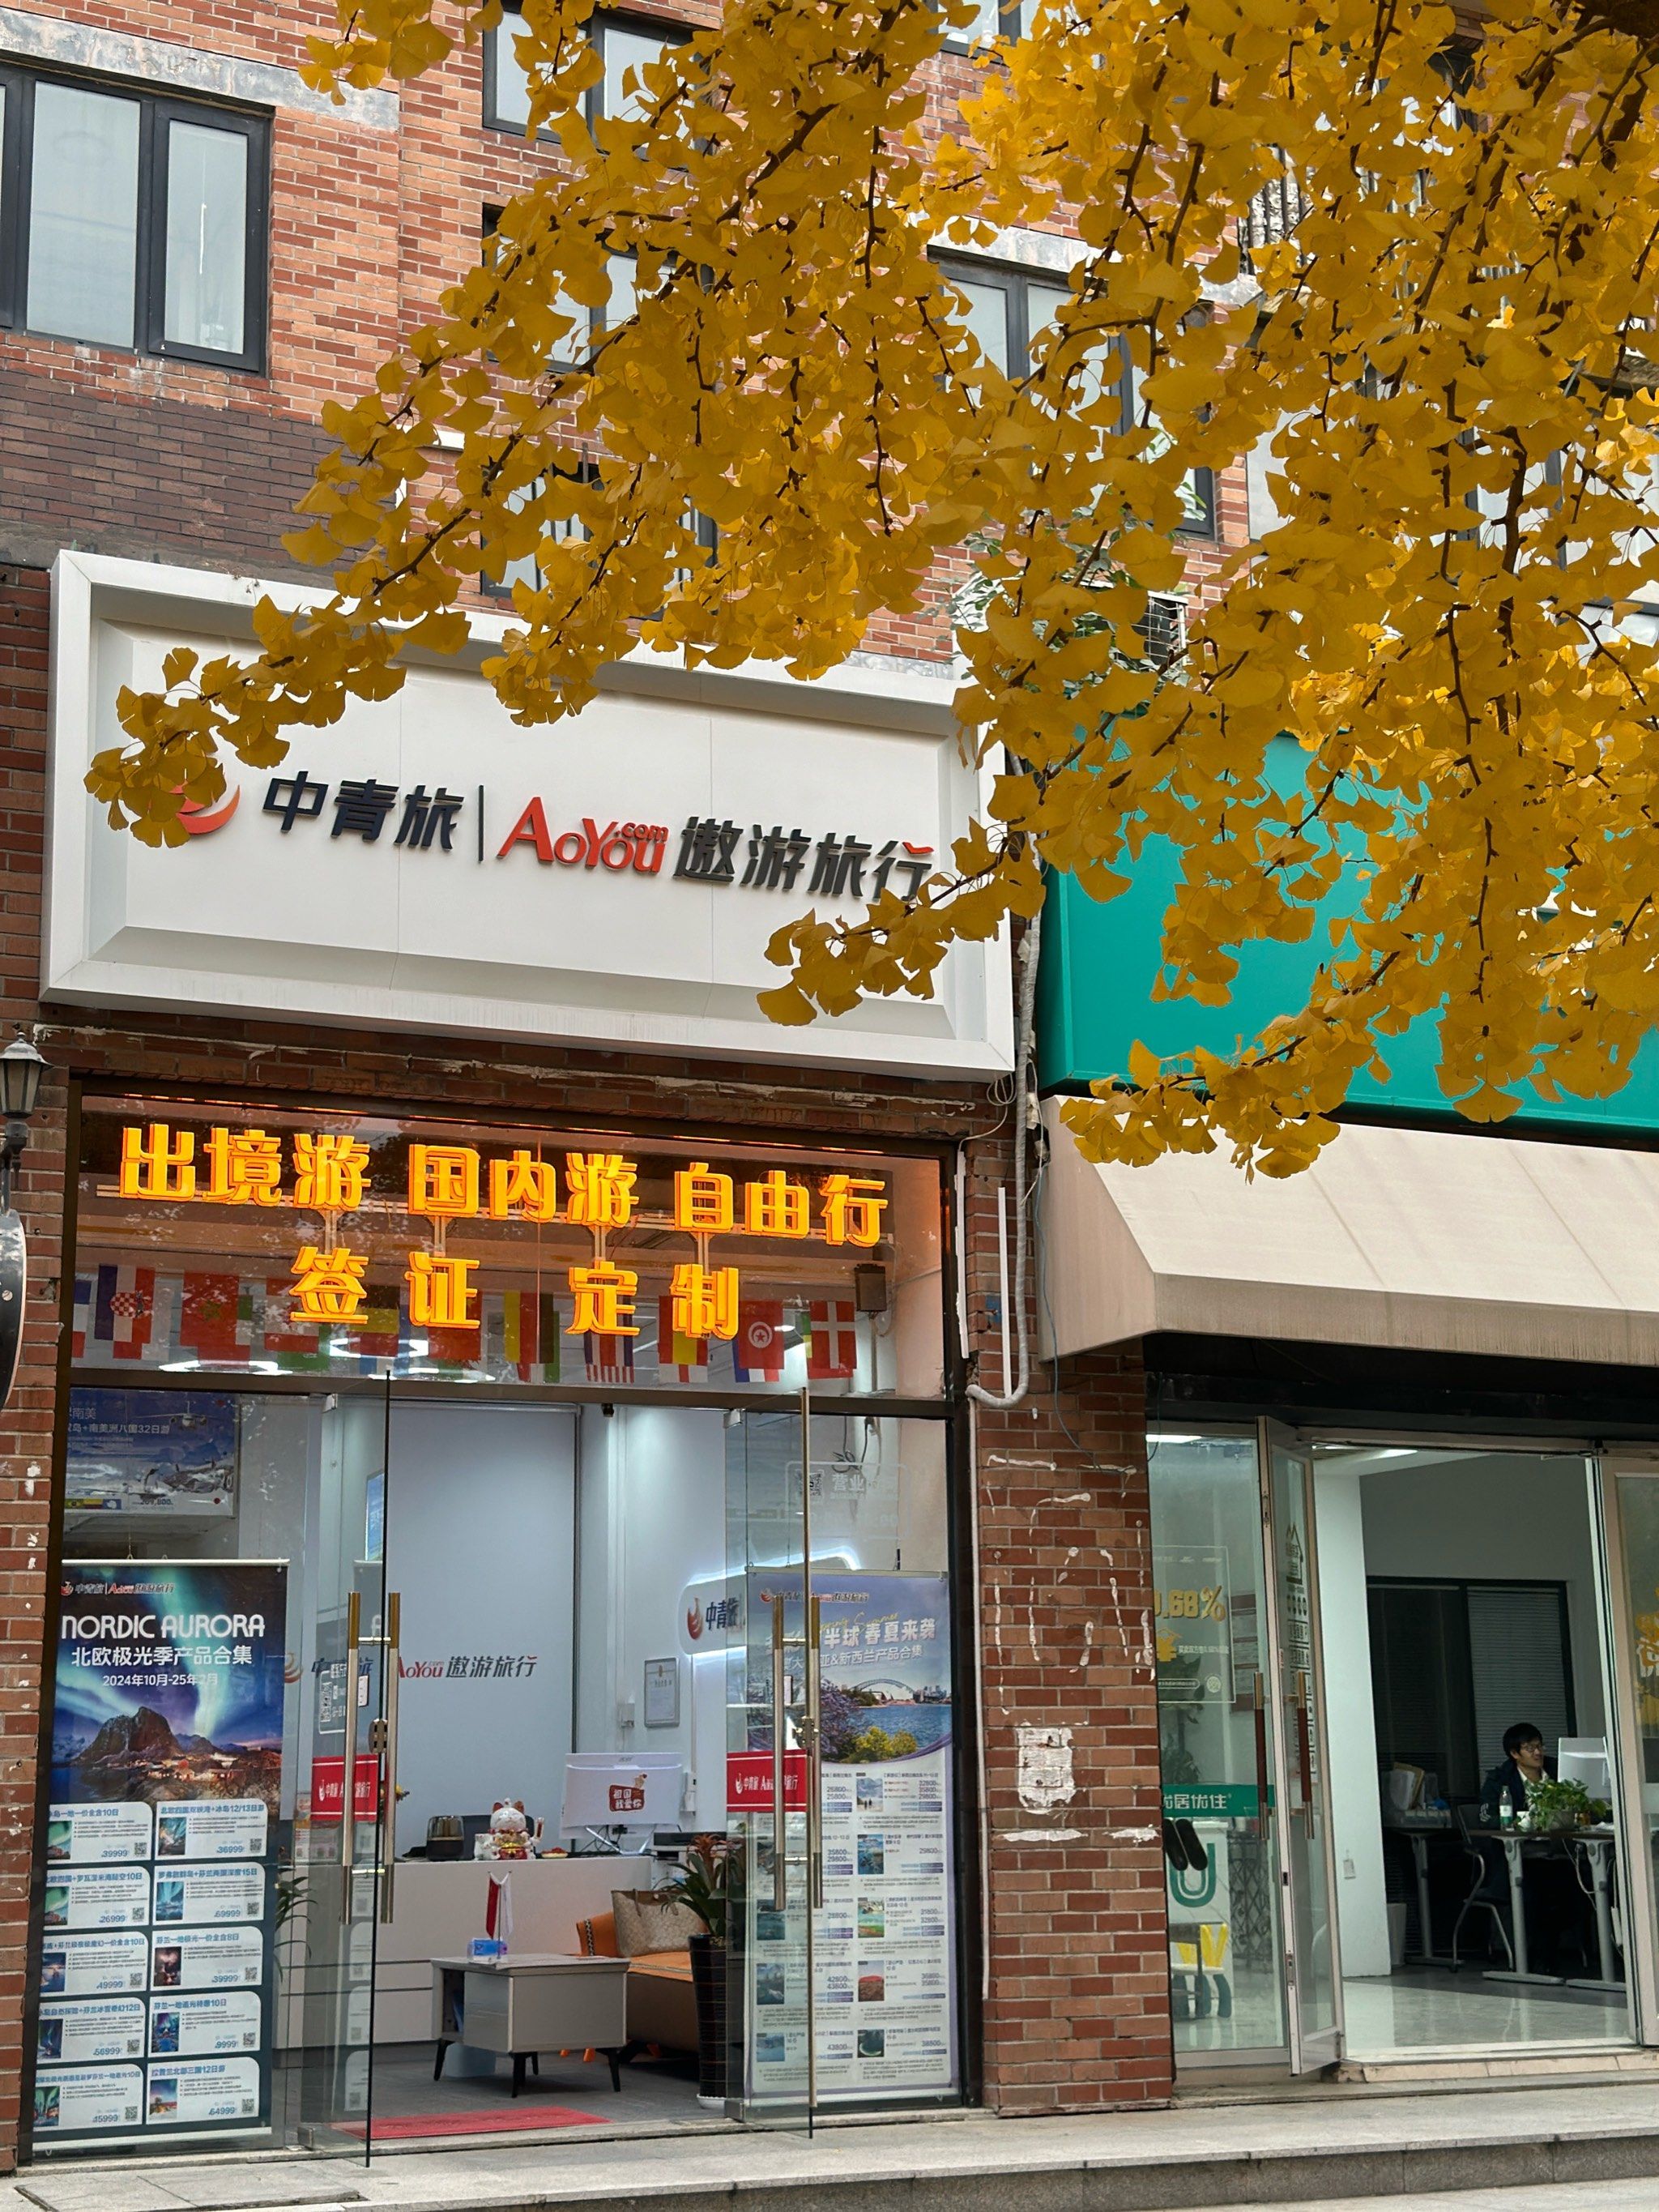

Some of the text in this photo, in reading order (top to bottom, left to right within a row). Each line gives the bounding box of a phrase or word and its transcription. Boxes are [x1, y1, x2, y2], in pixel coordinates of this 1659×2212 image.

[262, 771, 465, 851] 中青旅
[673, 816, 934, 902] 遨游旅行
[119, 1123, 889, 1248] 出境游 国内游 自由行
[289, 1246, 740, 1340] 签证 定制
[160, 1613, 266, 1639] AURORA
[71, 1645, 253, 1668] 北欧极光季产品合集
[446, 1655, 538, 1678] 遨游旅行
[783, 1644, 923, 1669] 大亚&新西兰产品合集
